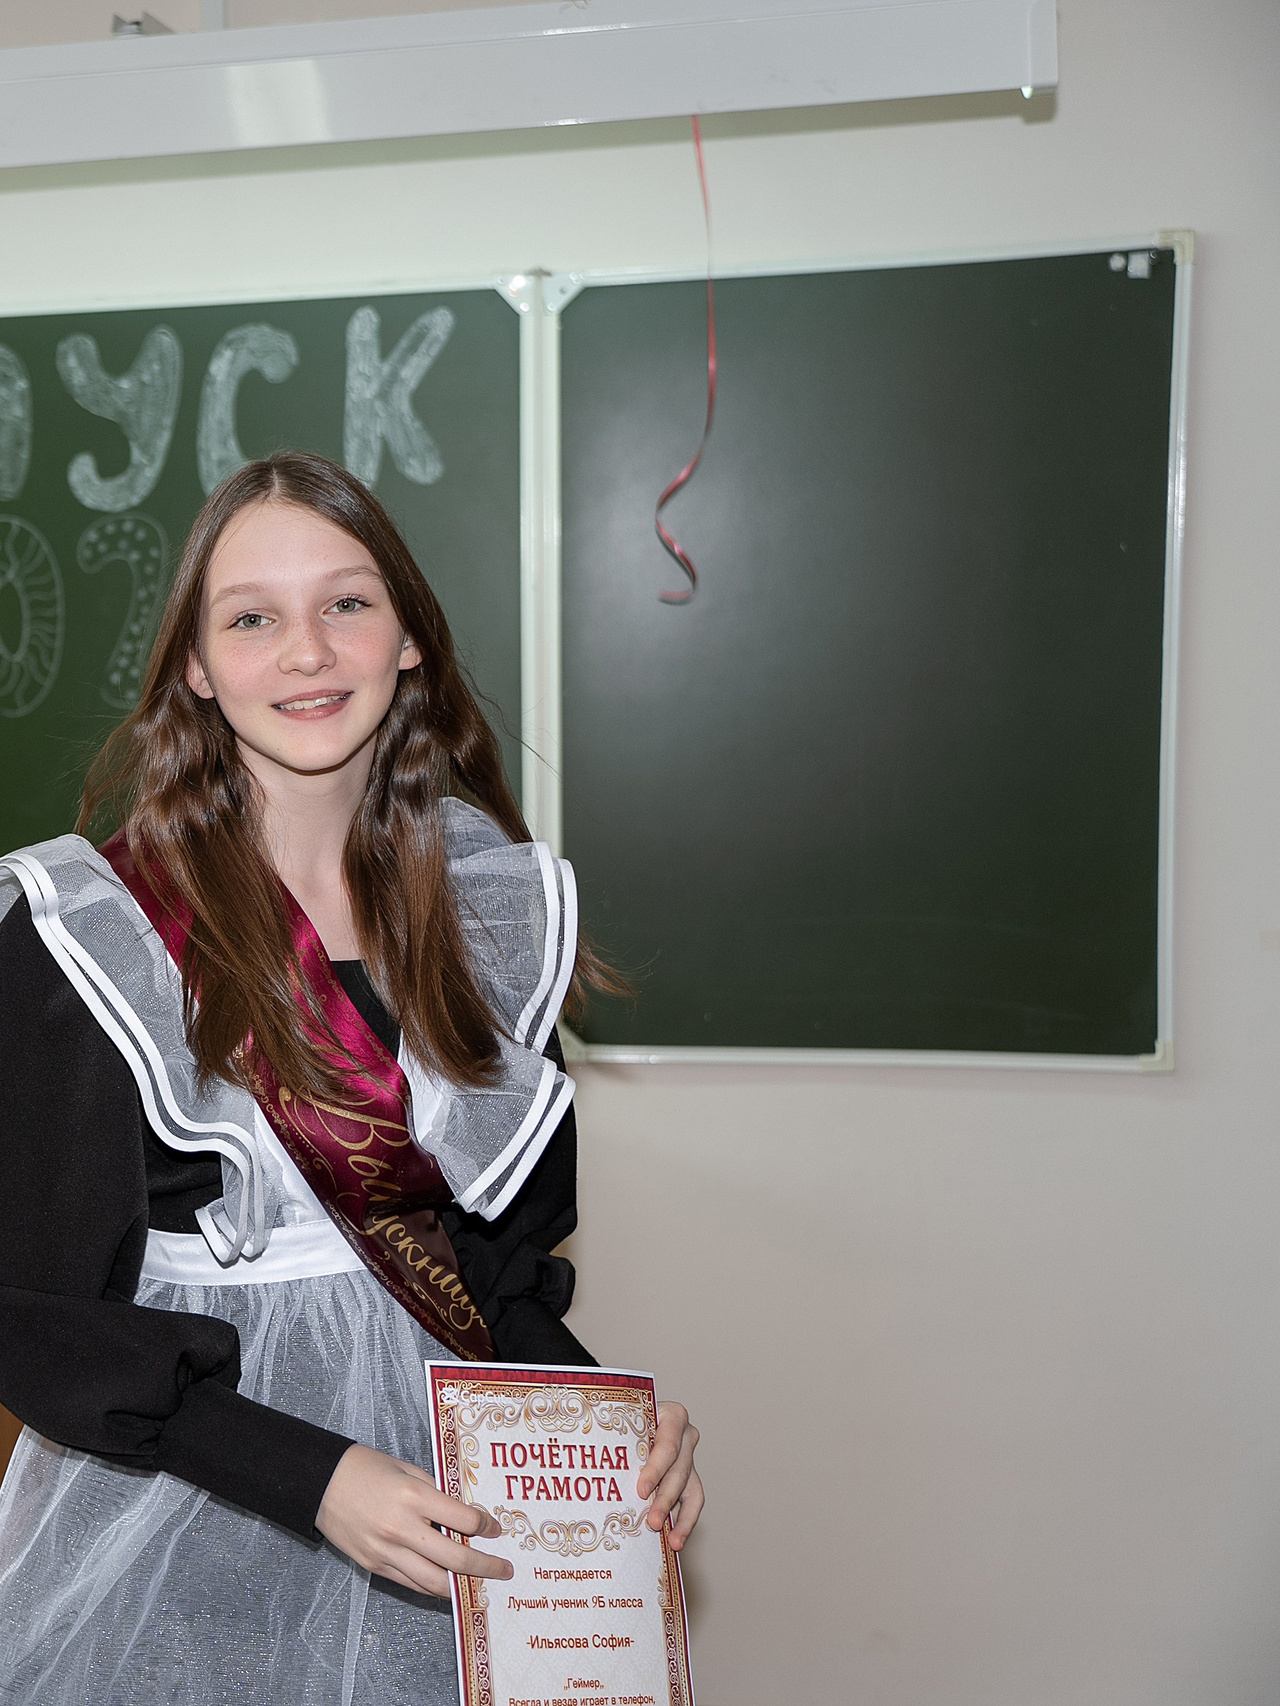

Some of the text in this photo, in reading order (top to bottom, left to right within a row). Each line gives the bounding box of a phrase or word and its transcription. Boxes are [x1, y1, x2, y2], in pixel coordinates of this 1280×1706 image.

[489, 1437, 630, 1471] ПОЧЁТНАЯ
[505, 1474, 624, 1502] ГРАМОТА
[533, 1567, 613, 1582] Награждается
[507, 1595, 644, 1612] Лучший ученик 9Б класса
[526, 1634, 635, 1651] -Ильясова София-
[611, 1697, 618, 1706] в
